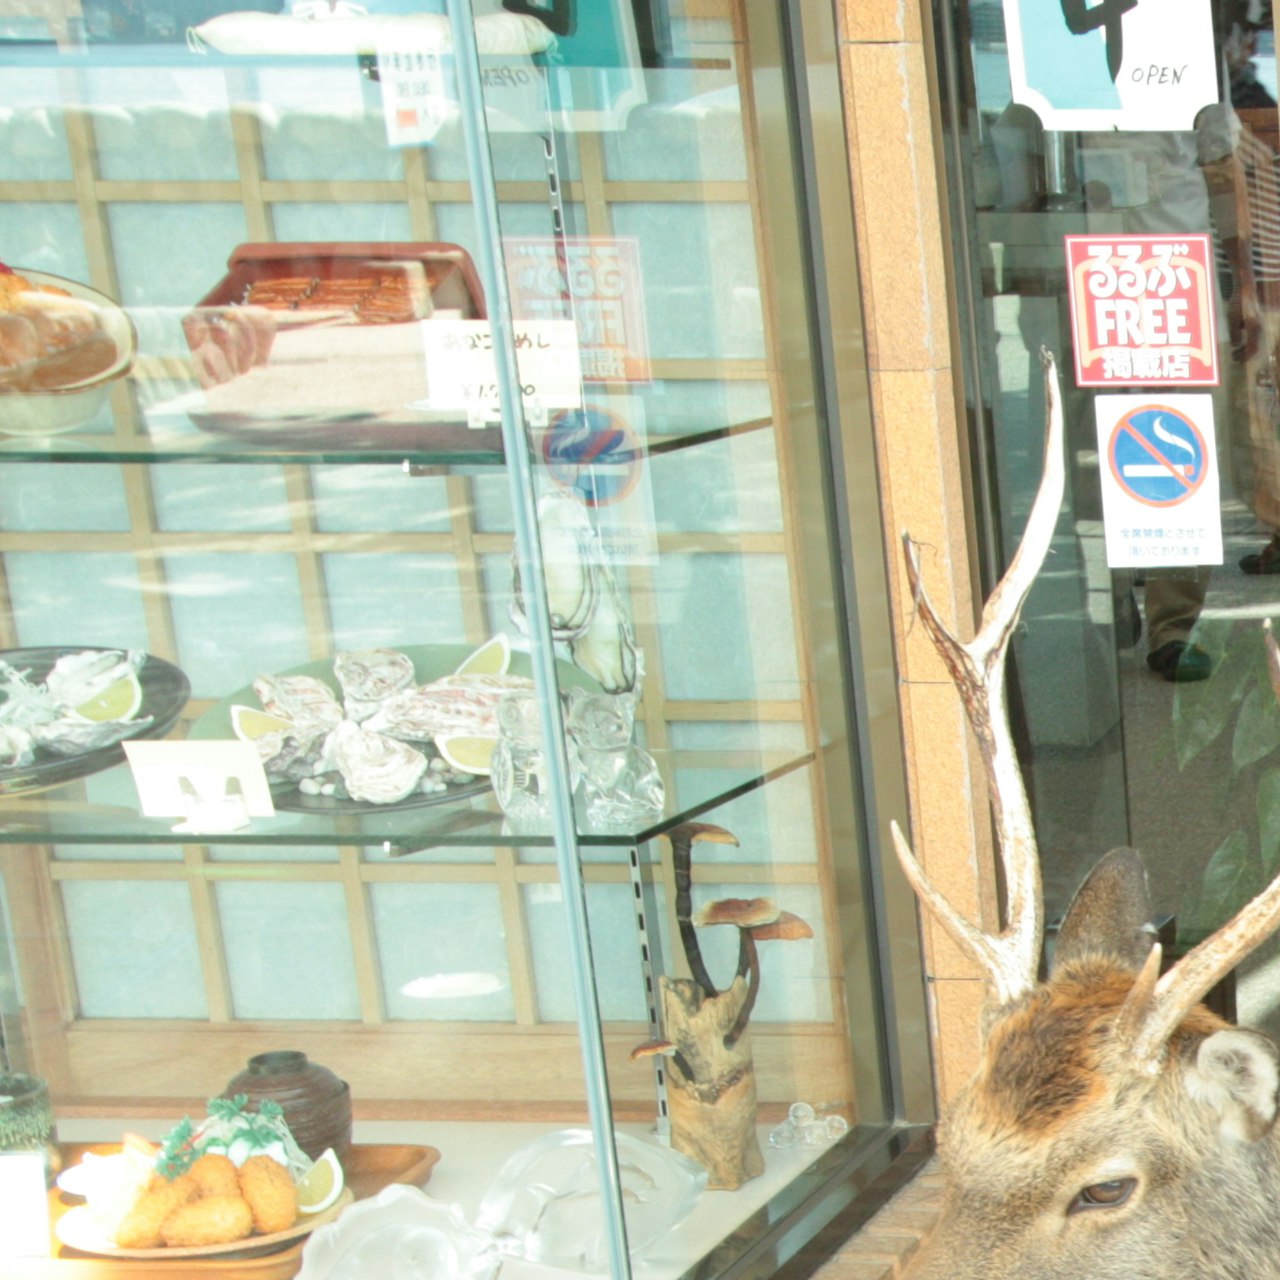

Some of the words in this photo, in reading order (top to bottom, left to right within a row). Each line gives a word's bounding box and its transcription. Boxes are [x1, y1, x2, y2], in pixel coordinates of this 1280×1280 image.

[1132, 65, 1188, 85] OPEN
[1087, 243, 1192, 298] るるぶ
[1094, 298, 1192, 345] FREE
[1103, 349, 1191, 379] 掲載店
